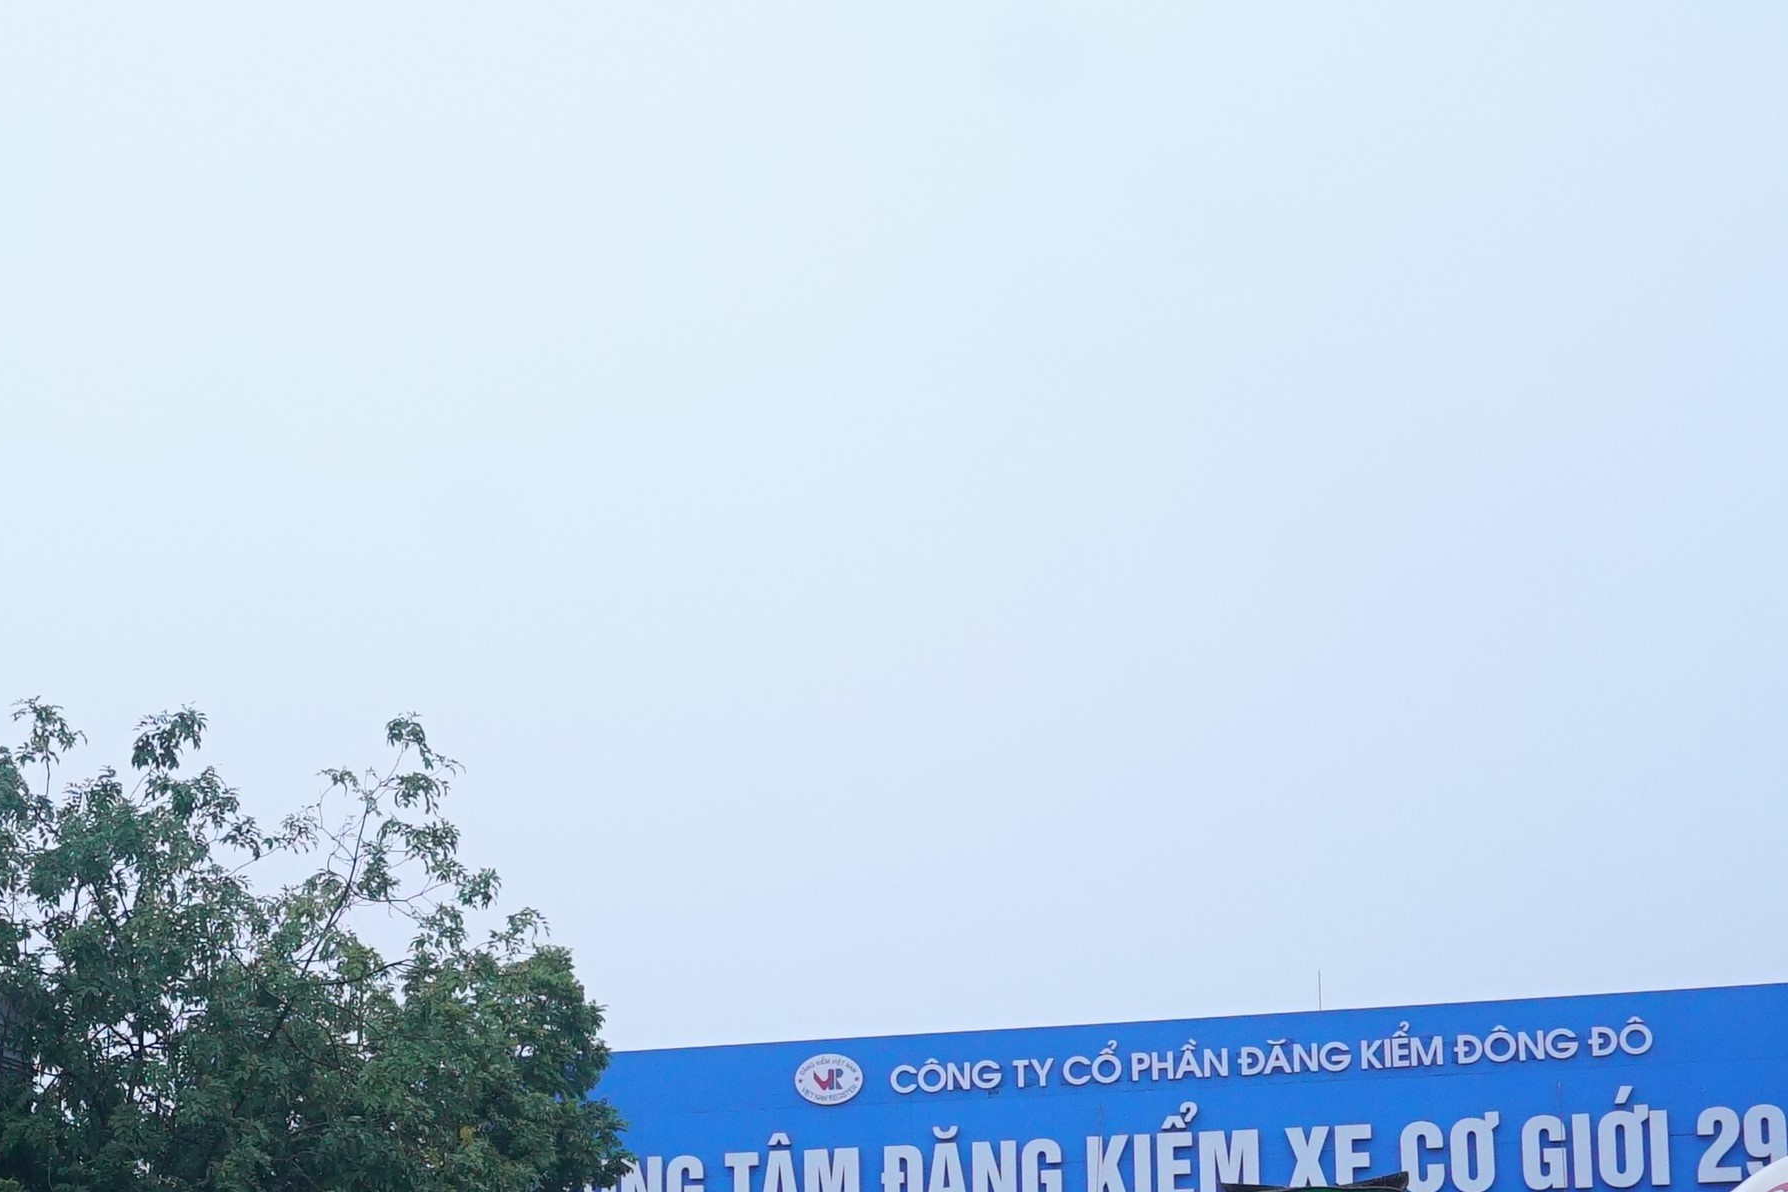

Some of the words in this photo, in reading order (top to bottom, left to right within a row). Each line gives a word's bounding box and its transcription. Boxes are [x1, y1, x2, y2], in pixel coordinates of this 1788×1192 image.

[890, 1057, 1002, 1094] CÔNG
[1013, 1056, 1054, 1089] TY
[1063, 1040, 1122, 1084] CỔ
[1131, 1037, 1228, 1081] PHẦN
[1238, 1038, 1351, 1076] ĐĂNG
[1361, 1021, 1444, 1070] KIỂM
[1454, 1025, 1579, 1064] ĐÔNG
[1588, 1016, 1653, 1057] ĐÔ
[1284, 1124, 1371, 1187] XE
[1521, 1085, 1671, 1190] GIỚI
